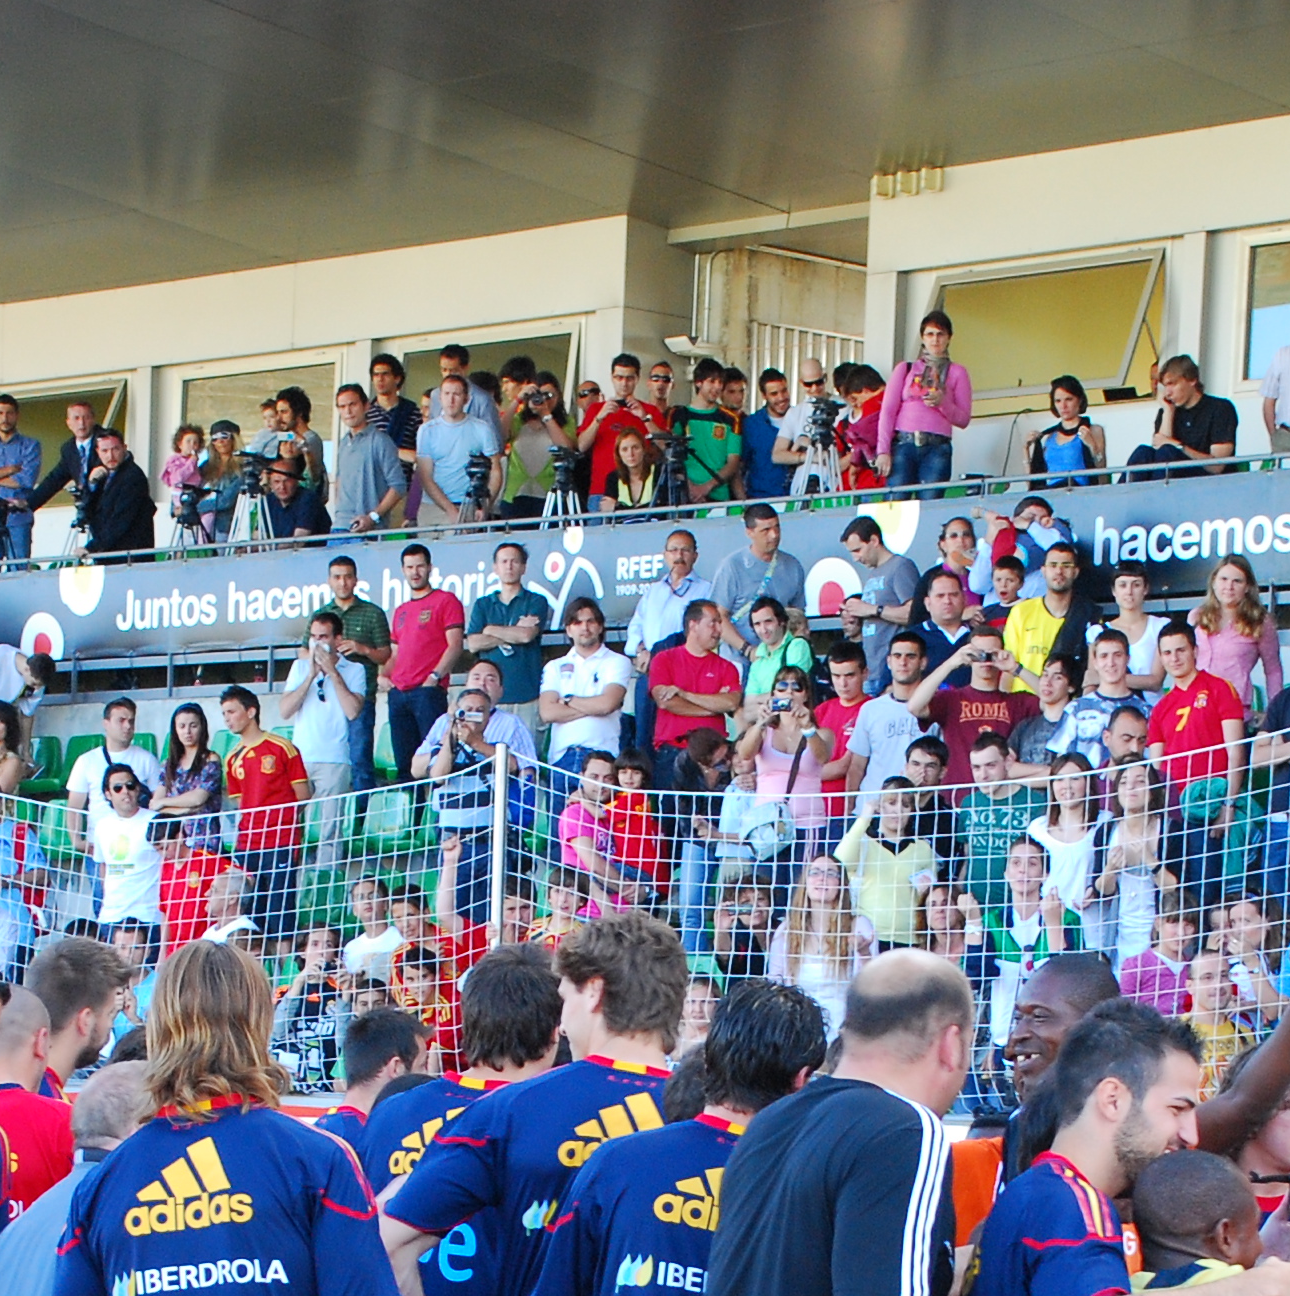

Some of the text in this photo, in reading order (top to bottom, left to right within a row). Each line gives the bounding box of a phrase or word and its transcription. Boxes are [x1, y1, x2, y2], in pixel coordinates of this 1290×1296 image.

[616, 553, 665, 581] RFEF
[115, 589, 218, 633] Juntos
[227, 580, 371, 625] hacems
[959, 701, 1010, 718] ROMA
[1175, 705, 1191, 732] 7
[1000, 808, 1028, 829] 73
[124, 1192, 254, 1237] adidas
[135, 1259, 290, 1296] IBERDROLA
